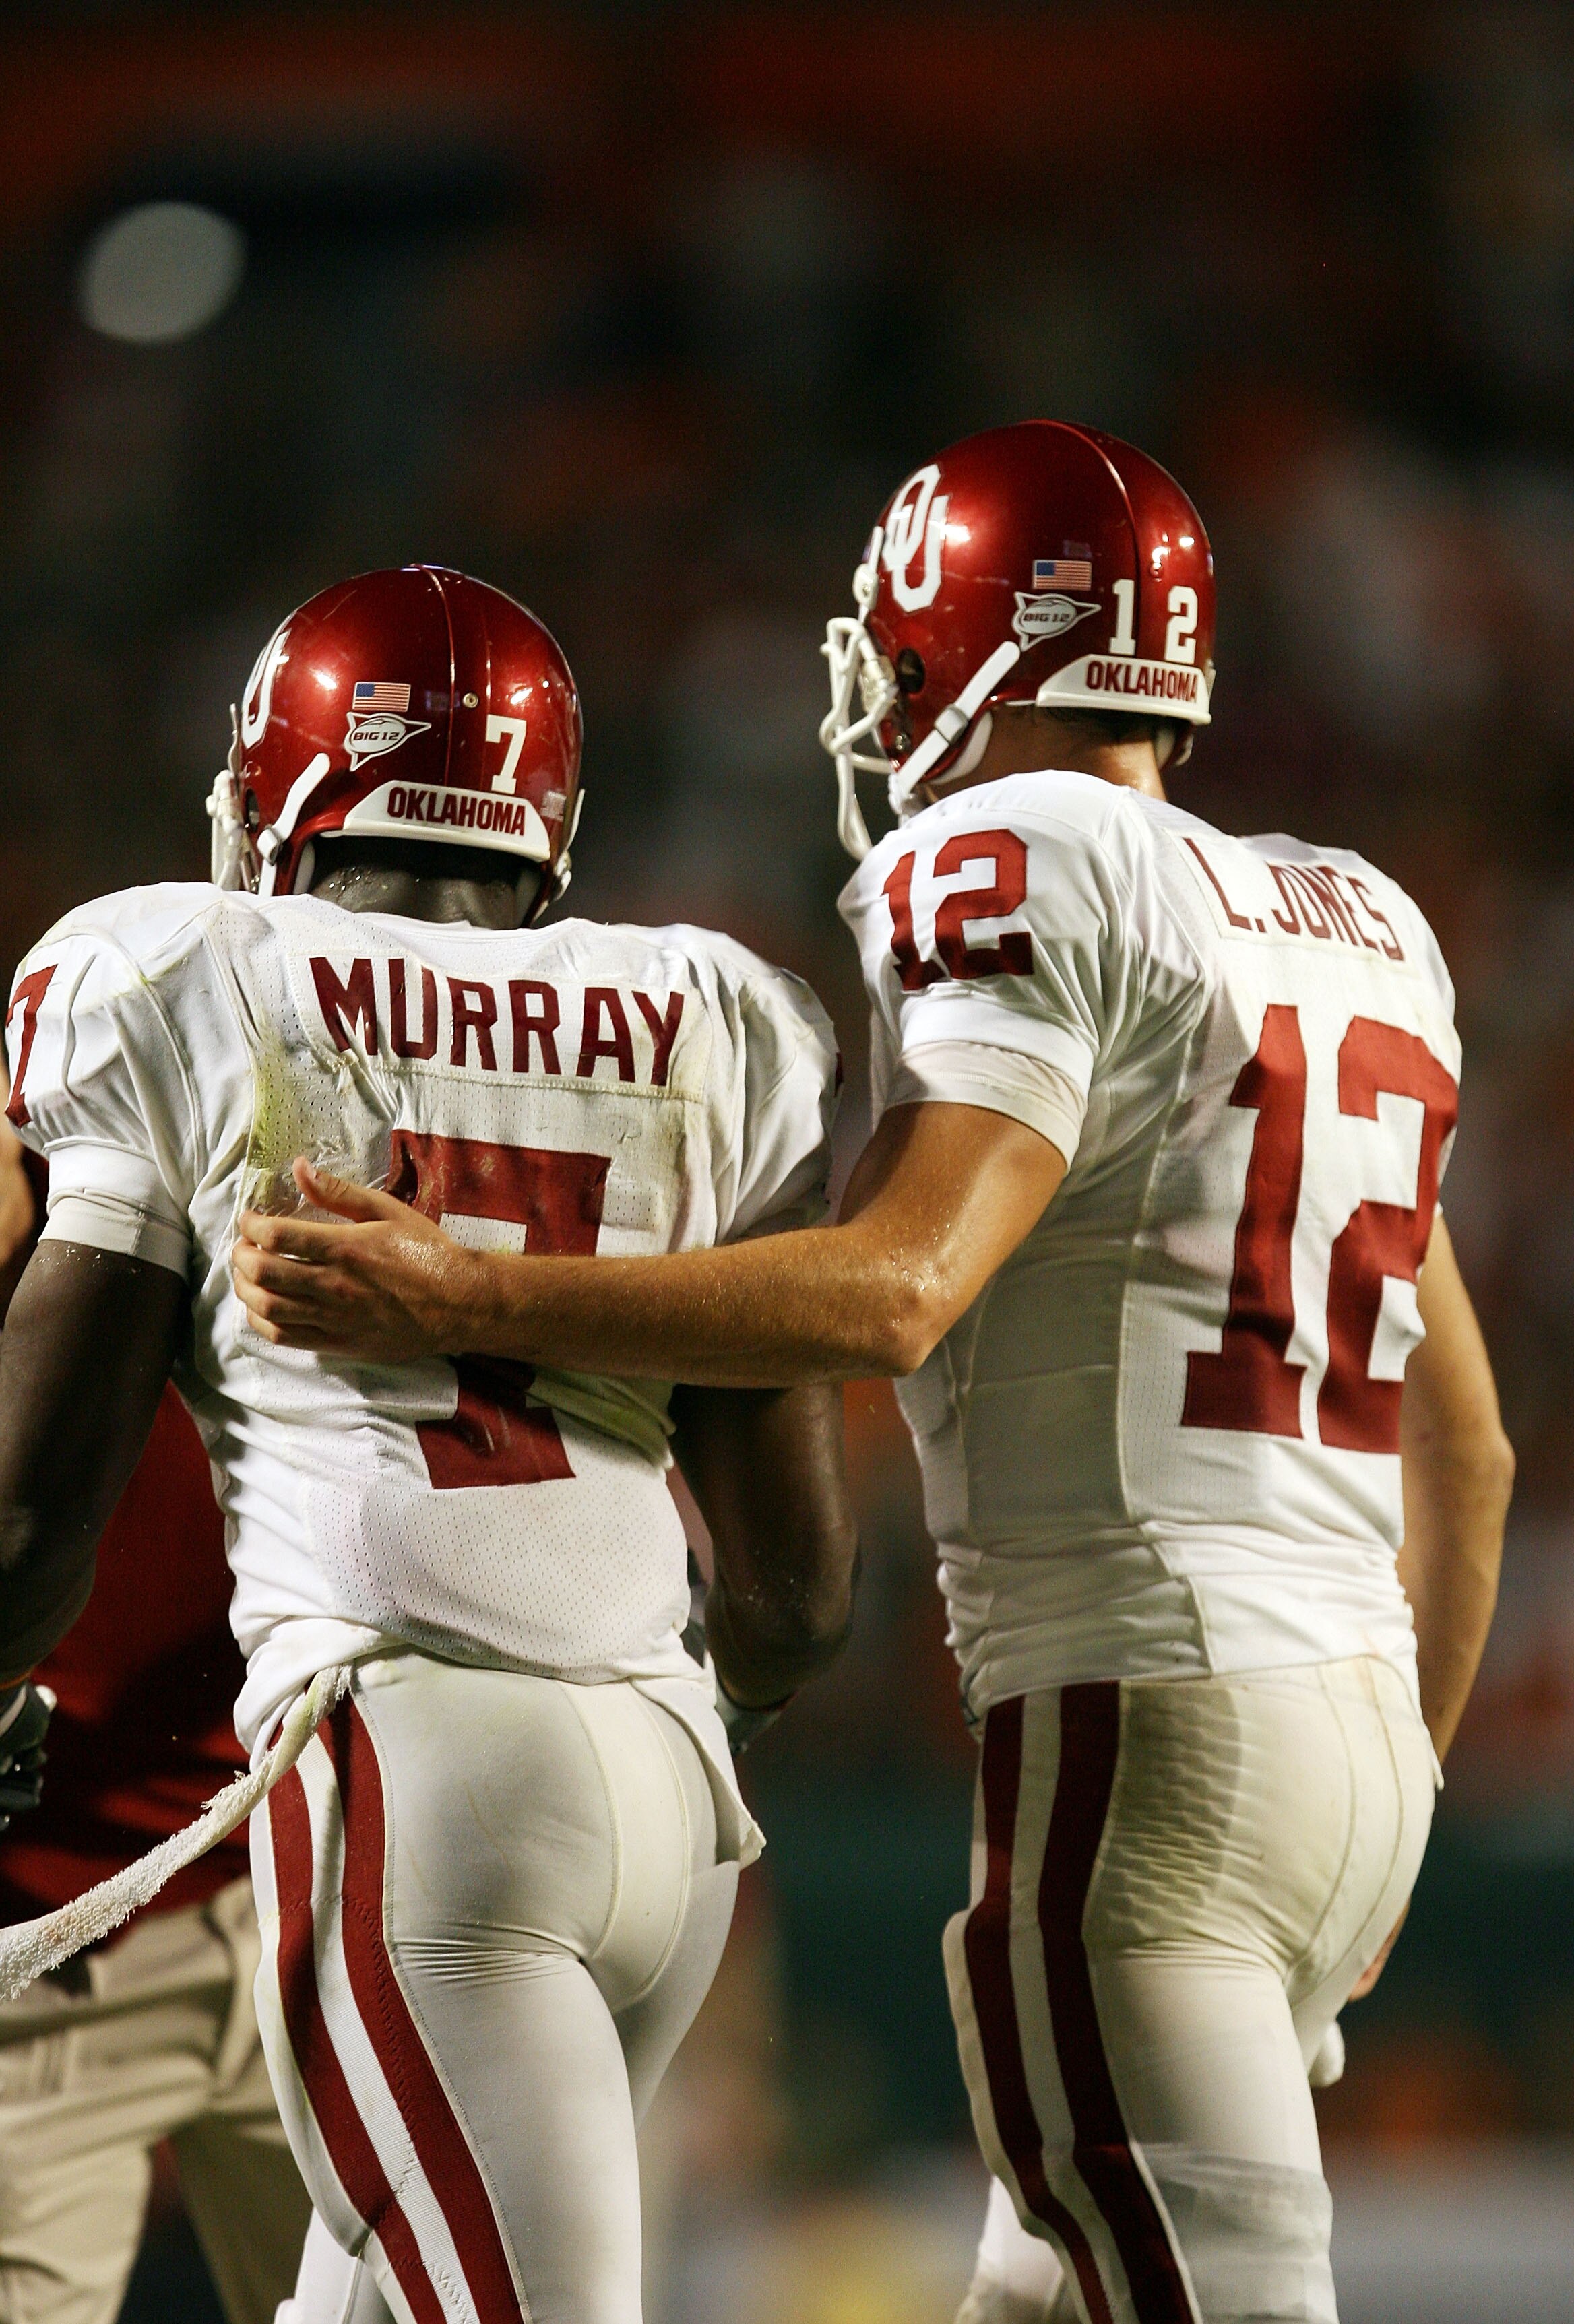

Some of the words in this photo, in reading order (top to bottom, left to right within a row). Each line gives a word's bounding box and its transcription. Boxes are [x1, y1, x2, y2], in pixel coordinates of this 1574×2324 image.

[881, 464, 949, 612] OU
[1023, 613, 1050, 622] BIG
[1052, 613, 1070, 622] 12
[1086, 660, 1198, 703] OKLAHOMA
[353, 732, 379, 740] BIG
[381, 732, 400, 740] 12
[485, 714, 527, 795] 7
[387, 787, 526, 837] OKLAHOMA
[880, 828, 1034, 991] 12
[5, 963, 59, 1130] 7
[309, 956, 685, 1086] MURRAY
[1180, 1003, 1459, 1454] 12
